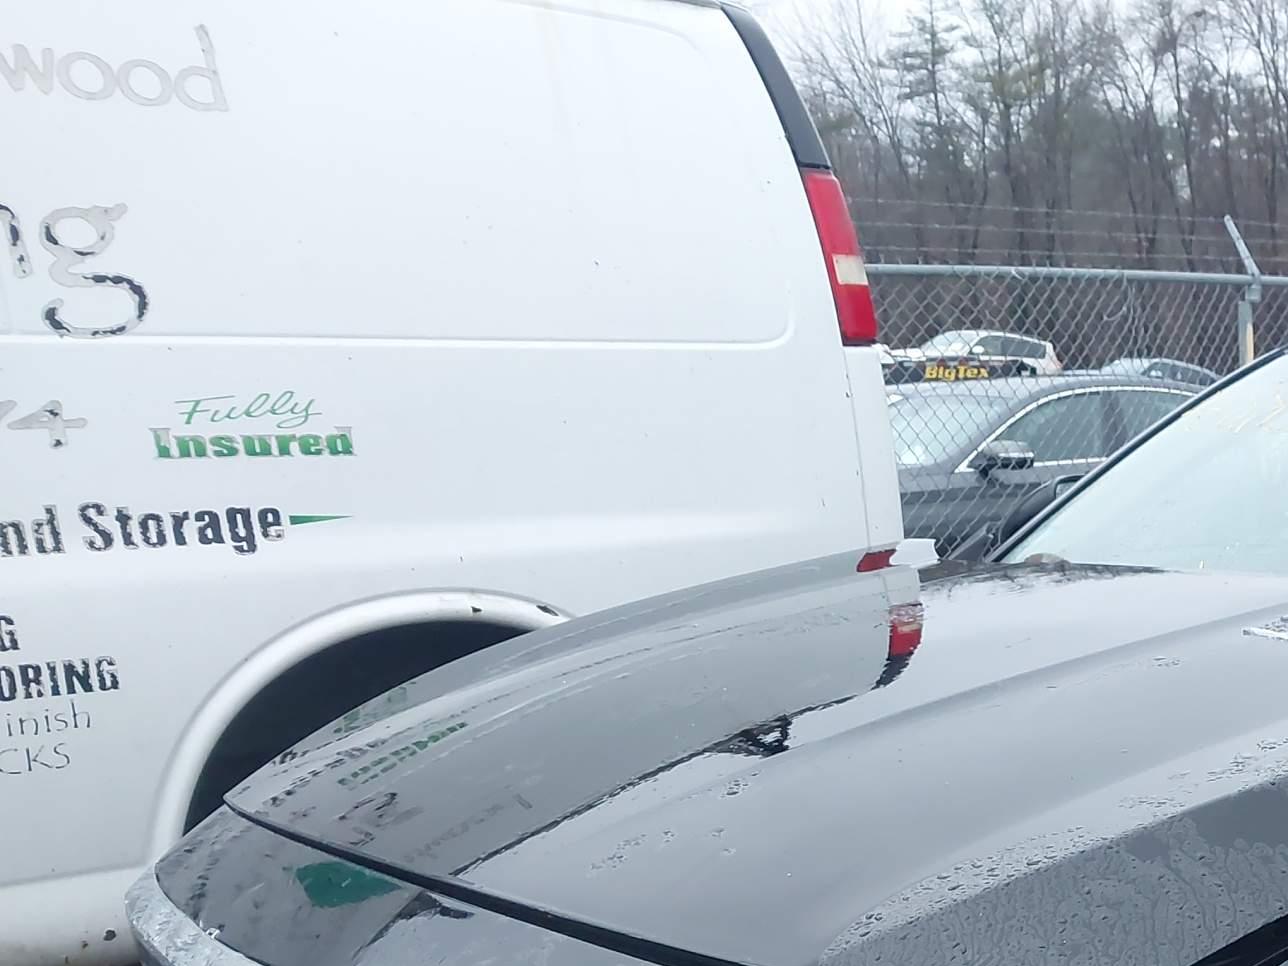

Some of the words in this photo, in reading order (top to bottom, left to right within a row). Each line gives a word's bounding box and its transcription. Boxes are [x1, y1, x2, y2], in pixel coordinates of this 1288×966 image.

[174, 390, 323, 429] Fully
[149, 426, 356, 459] Insured
[78, 502, 285, 555] Storage
